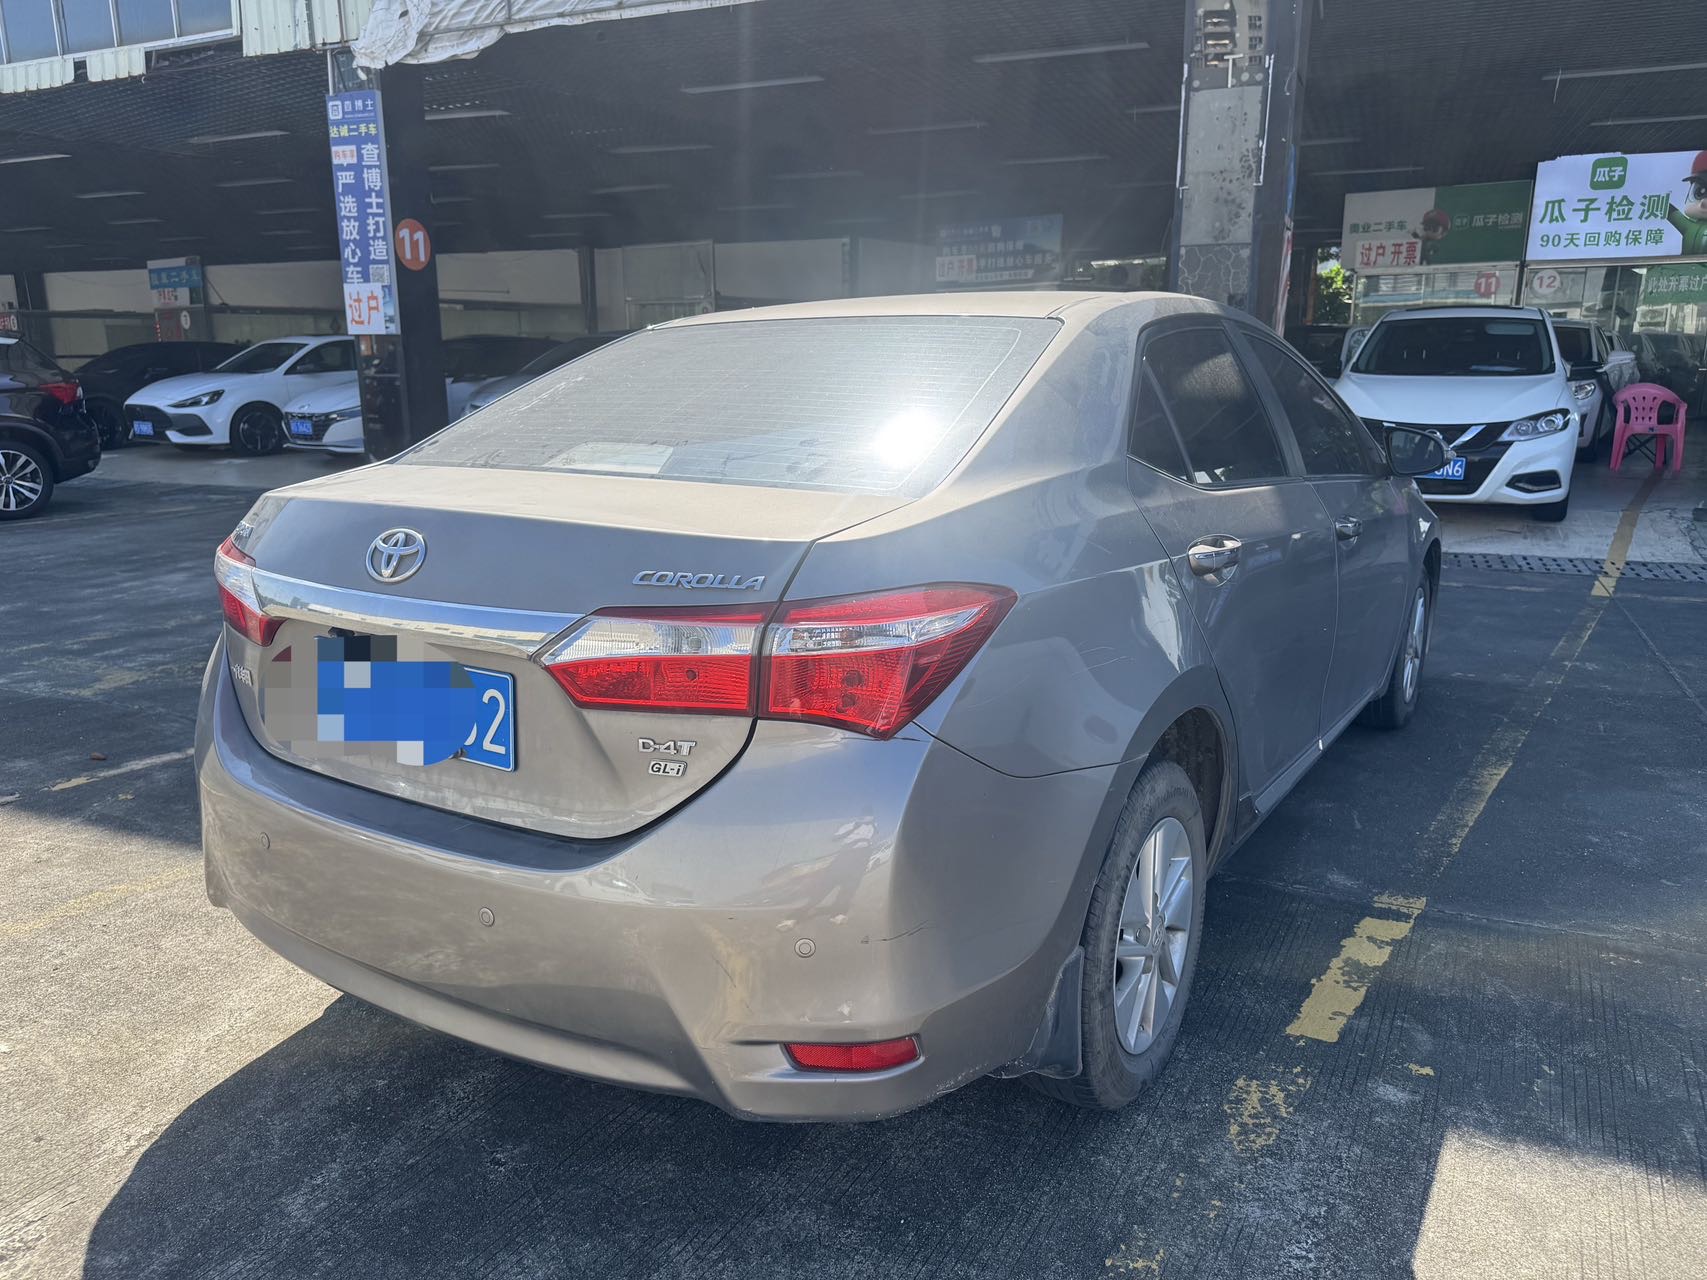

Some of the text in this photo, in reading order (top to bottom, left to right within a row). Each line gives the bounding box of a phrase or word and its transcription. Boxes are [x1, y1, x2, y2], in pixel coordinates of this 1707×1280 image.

[1593, 166, 1625, 182] 瓜子
[360, 142, 389, 261] 查博士打造
[1538, 192, 1671, 225] 瓜子检测
[336, 171, 365, 285] 严选放心车
[1539, 228, 1665, 249] 90天回购保障
[398, 227, 426, 263] 11
[1478, 276, 1497, 293] 11
[1536, 275, 1557, 289] 12
[349, 290, 380, 326] 过户
[632, 570, 766, 591] COROLLA
[638, 737, 697, 756] D-4T
[650, 762, 682, 776] GL-i
